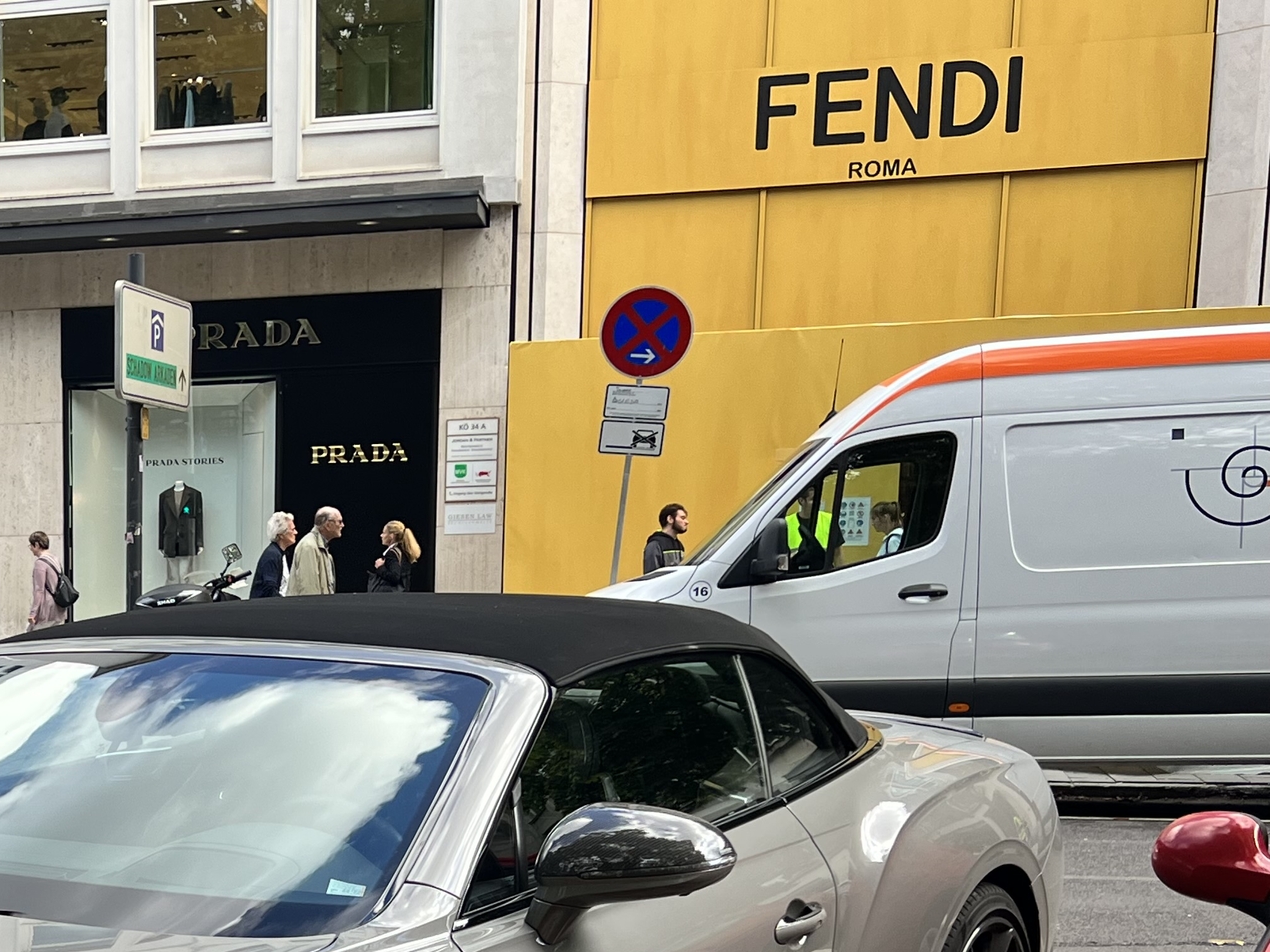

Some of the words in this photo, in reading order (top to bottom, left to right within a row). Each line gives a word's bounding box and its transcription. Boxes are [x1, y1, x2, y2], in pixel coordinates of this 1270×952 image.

[755, 56, 1024, 151] FENDI
[848, 158, 917, 179] ROMA
[191, 318, 322, 350] RADA
[126, 356, 152, 380] SCHADOW
[153, 364, 177, 387] ARKADEN
[145, 458, 179, 467] PRADA
[181, 456, 225, 466] STORIES
[310, 442, 409, 465] PRADA
[693, 586, 709, 597] 16
